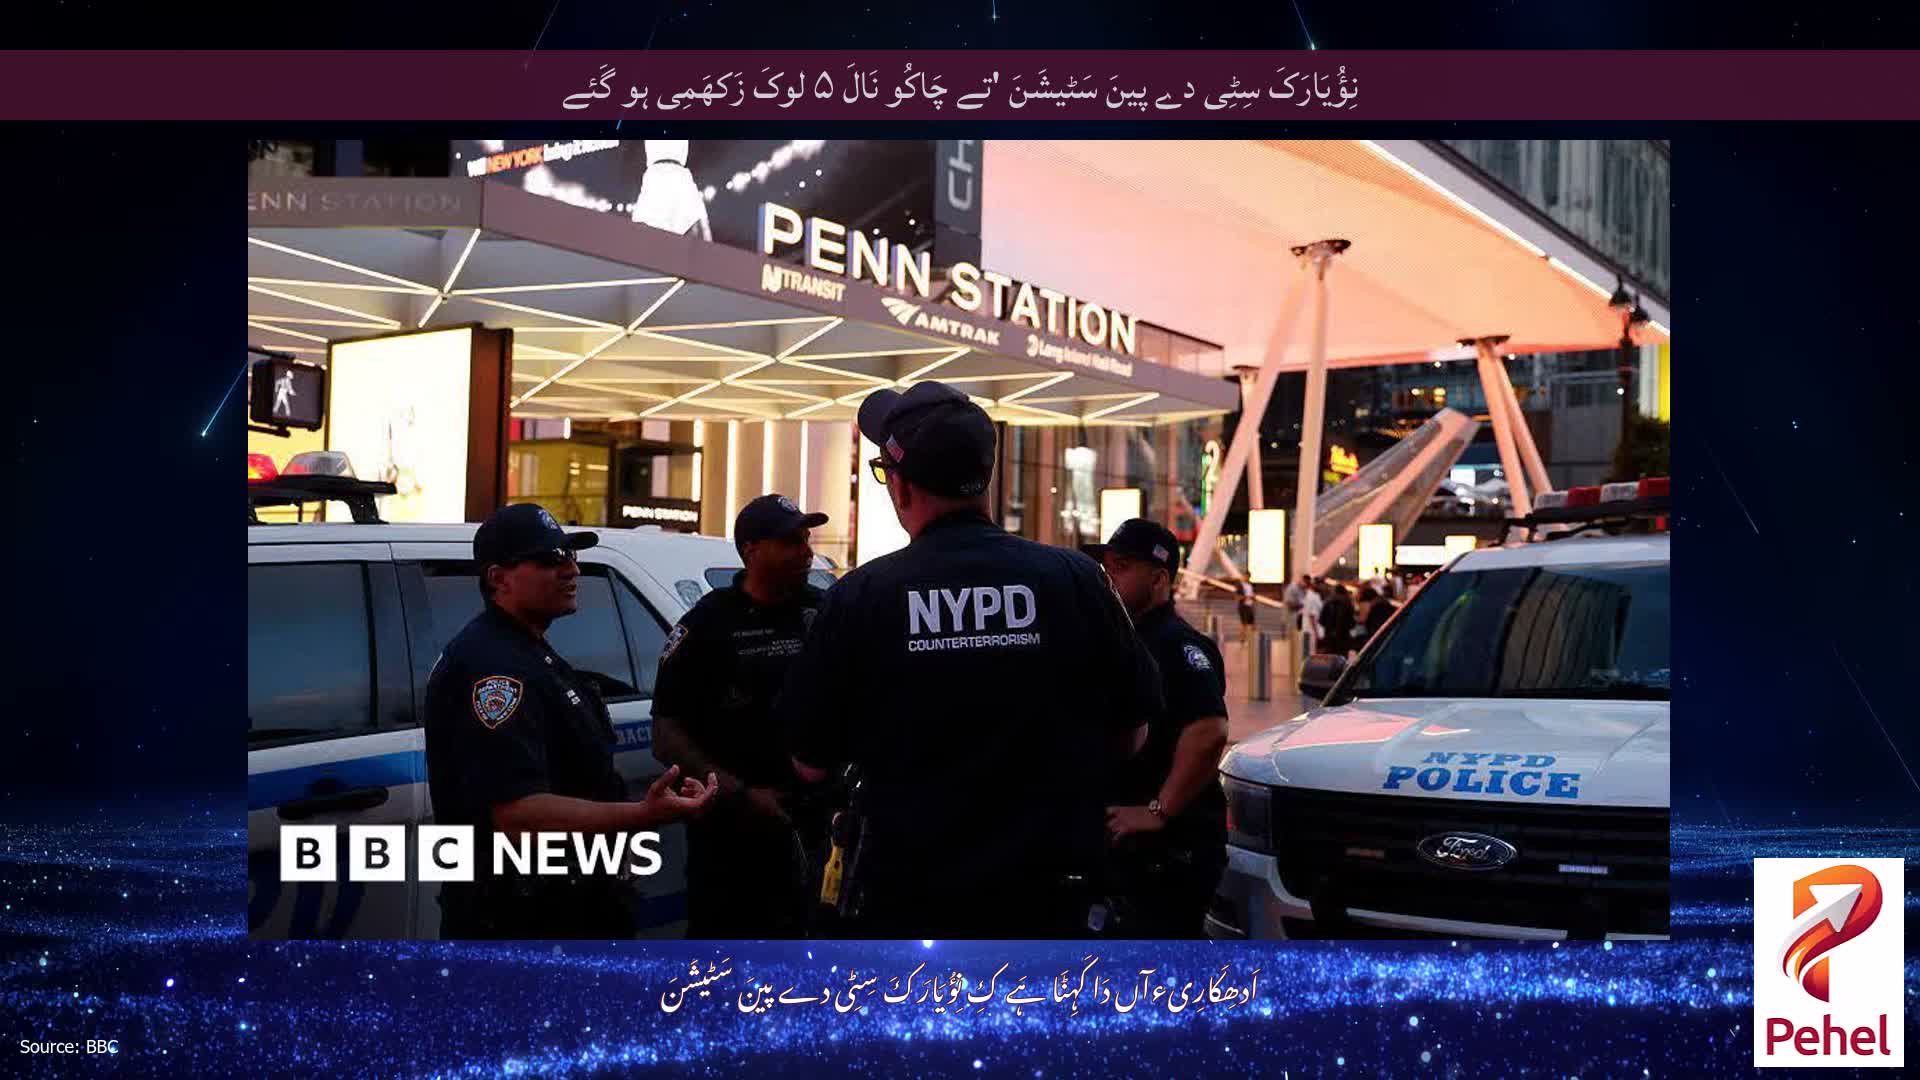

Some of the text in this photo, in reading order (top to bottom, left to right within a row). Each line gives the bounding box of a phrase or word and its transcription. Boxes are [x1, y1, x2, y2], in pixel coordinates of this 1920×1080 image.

[319, 191, 463, 213] STATION
[759, 201, 1137, 355] PENN STATION
[914, 311, 1001, 347] AMTRAK
[907, 583, 1037, 635] NYPD
[907, 632, 1041, 653] COUNTERTERRORISM
[1421, 750, 1558, 769] NYPD
[1381, 765, 1582, 799] POLICE
[1435, 835, 1491, 863] Ford
